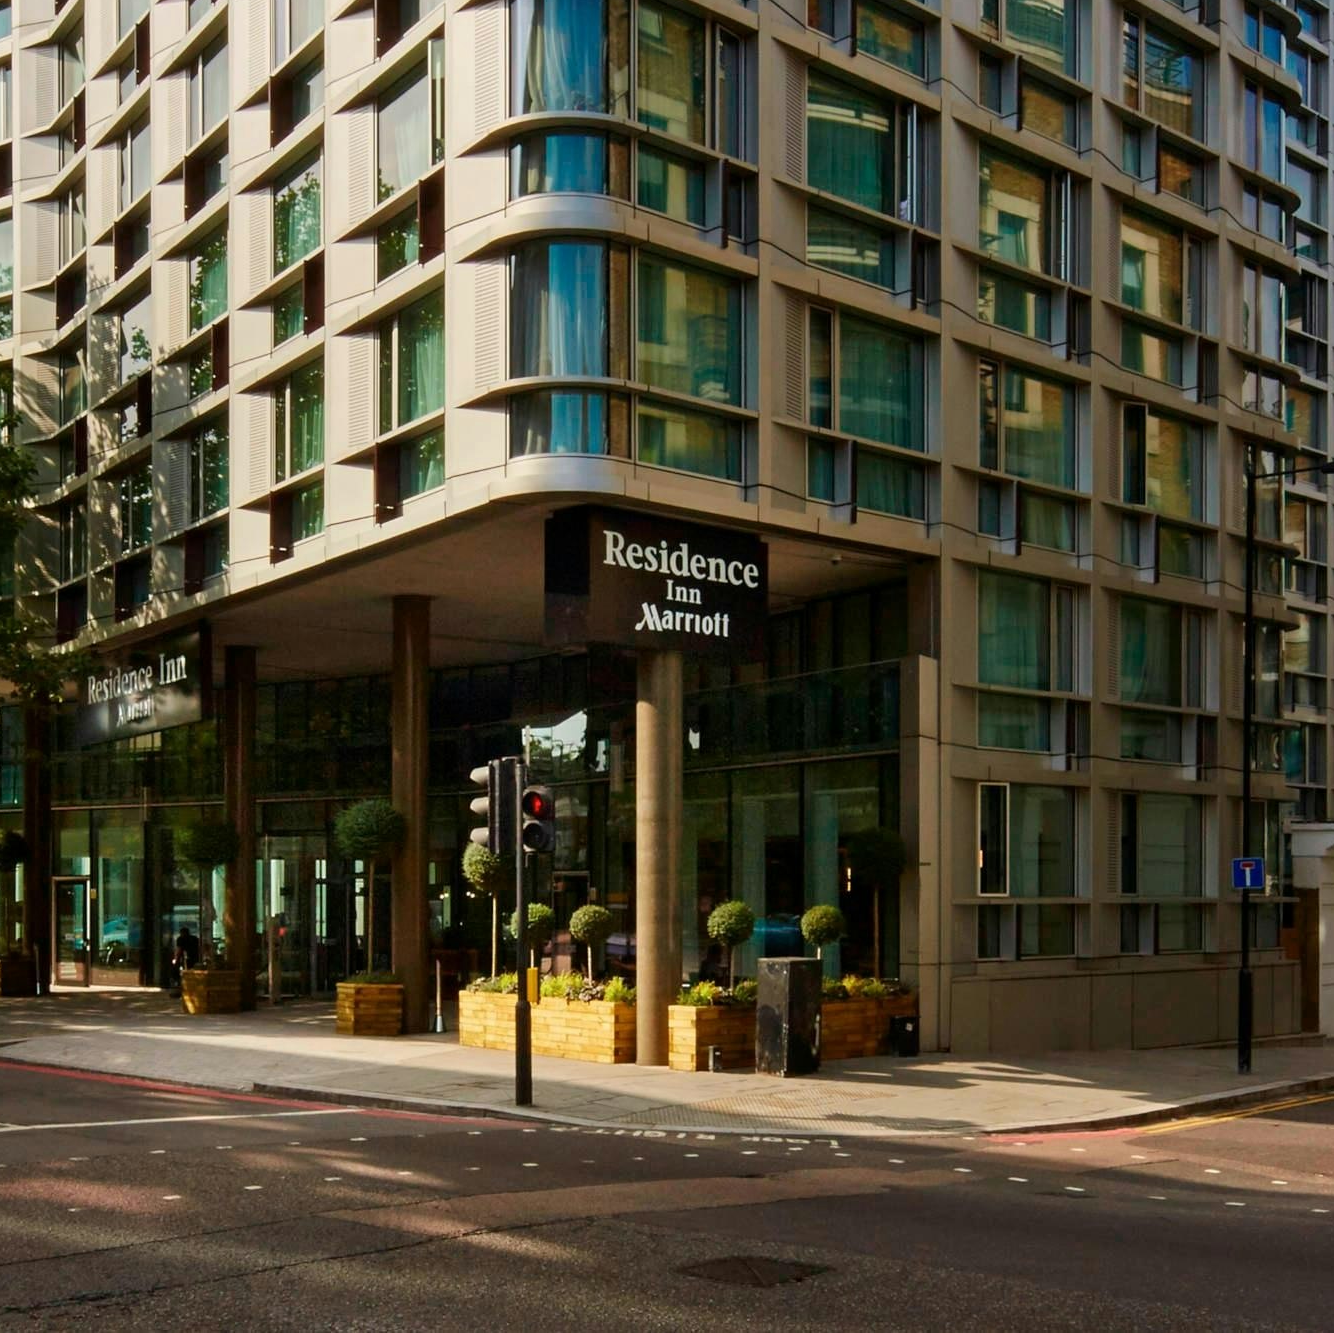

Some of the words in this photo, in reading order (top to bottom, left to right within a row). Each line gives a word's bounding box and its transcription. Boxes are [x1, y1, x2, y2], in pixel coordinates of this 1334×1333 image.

[603, 530, 759, 588] Residence
[666, 579, 702, 604] Inn
[634, 602, 729, 638] Marriott
[87, 666, 153, 704] Residence
[158, 653, 187, 686] Inn
[581, 1128, 716, 1140] RIGHT
[739, 1135, 841, 1149] LOOK
